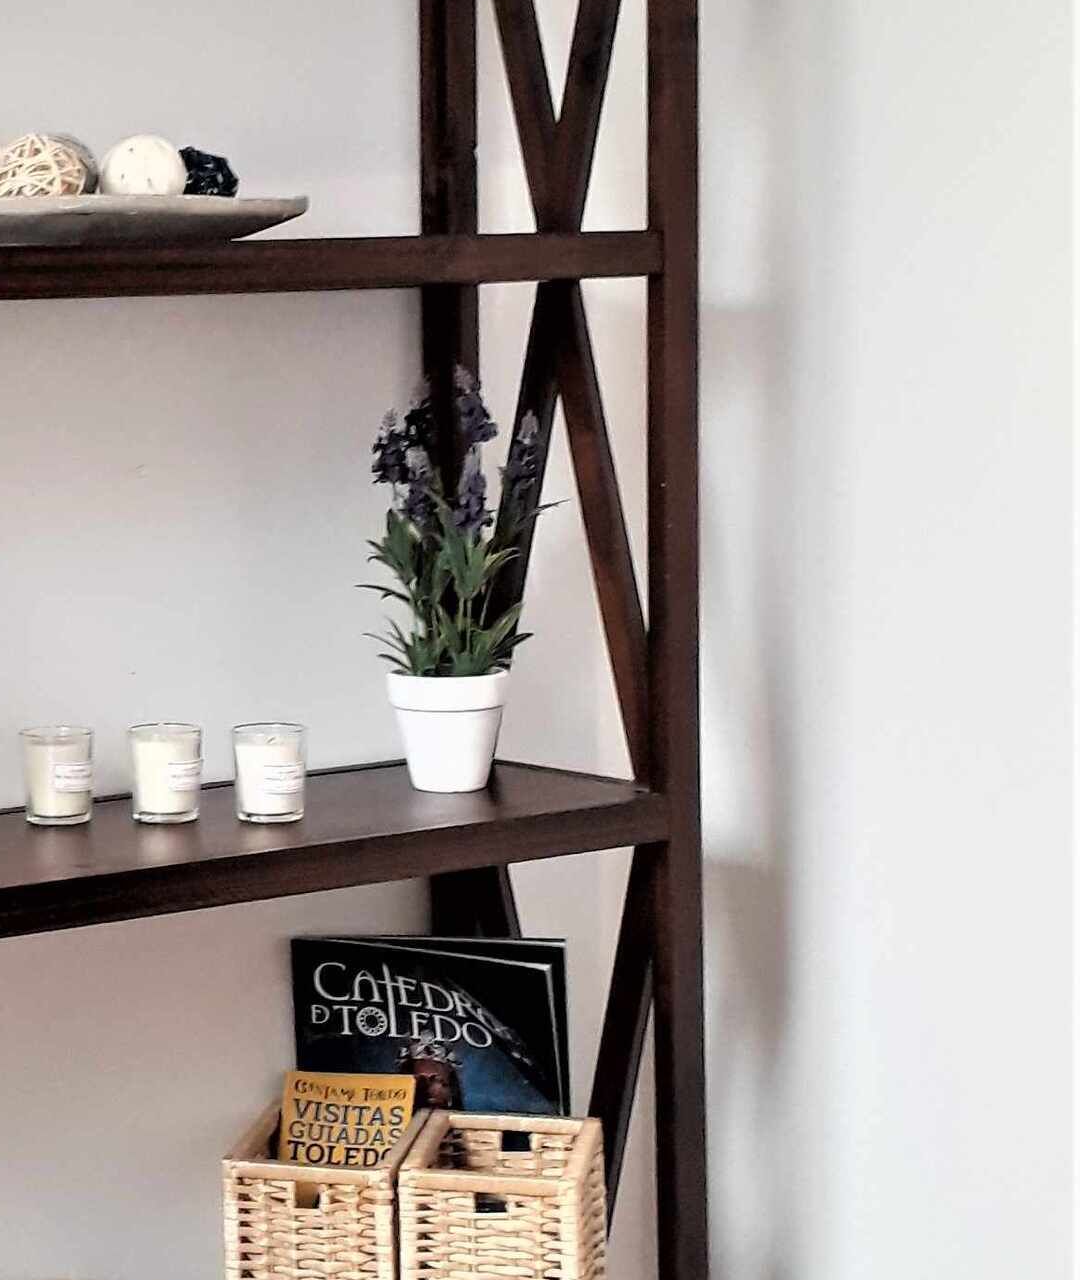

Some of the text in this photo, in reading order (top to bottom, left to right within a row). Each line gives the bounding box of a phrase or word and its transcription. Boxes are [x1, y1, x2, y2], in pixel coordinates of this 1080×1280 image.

[332, 1004, 492, 1048] TOLEDO
[293, 1098, 405, 1127] VISITAS
[288, 1120, 402, 1146] GUIADAS
